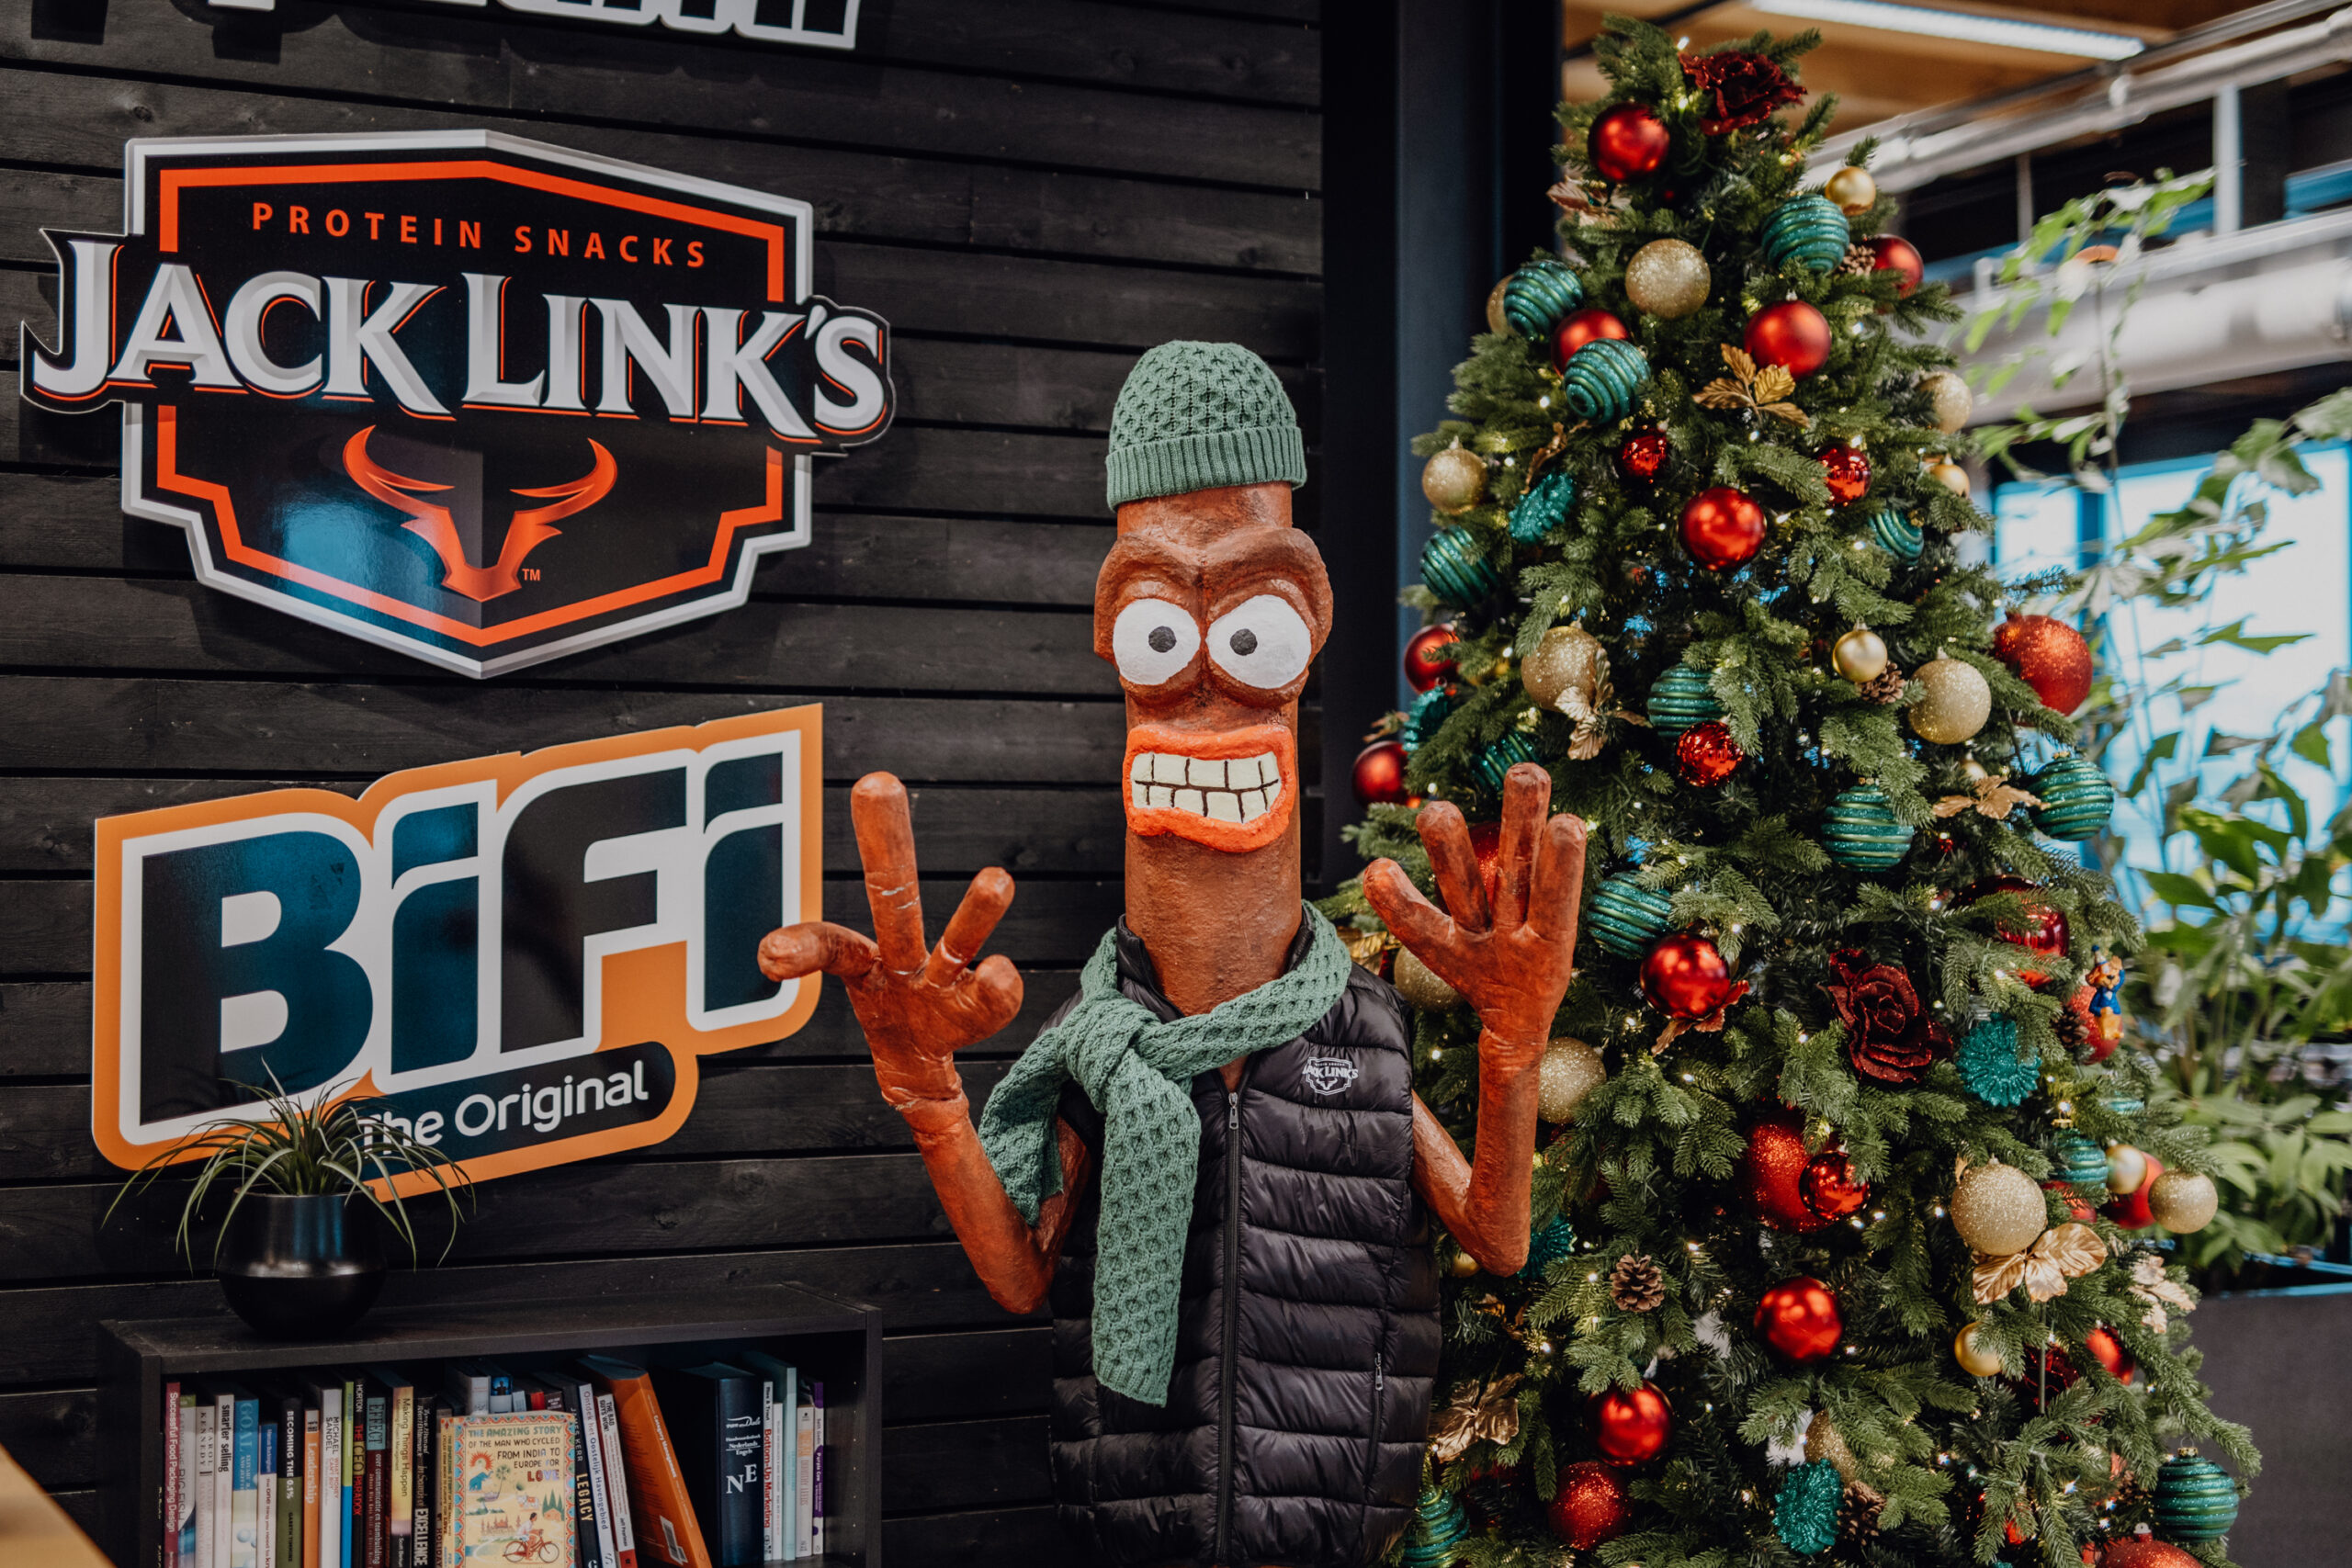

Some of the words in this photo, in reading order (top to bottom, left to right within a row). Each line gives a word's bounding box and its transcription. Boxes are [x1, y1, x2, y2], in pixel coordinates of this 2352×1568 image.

[252, 202, 481, 249] PROTEIN
[514, 225, 705, 268] SNACKS
[32, 237, 452, 420] JACK
[459, 272, 888, 443] LINK'S
[522, 568, 541, 581] TM
[138, 750, 784, 1126] BiFi
[357, 1110, 445, 1159] The
[454, 1059, 650, 1137] Original
[355, 1383, 364, 1413] HORTON
[401, 1397, 411, 1429] Making
[583, 1391, 594, 1421] Ontdek
[599, 1399, 608, 1416] GUYS
[169, 1392, 178, 1438] Successful
[221, 1404, 231, 1440] smarter
[239, 1402, 253, 1452] GOAL
[368, 1404, 384, 1445] EFFECT
[607, 1414, 616, 1427] BAD
[354, 1424, 364, 1441] THE
[401, 1432, 411, 1461] Things
[468, 1429, 484, 1438] THE
[486, 1427, 530, 1437] AMAZING
[533, 1425, 563, 1435] STORY
[469, 1440, 477, 1449] OF
[494, 1438, 512, 1447] MAN
[513, 1438, 531, 1447] WHO
[532, 1437, 560, 1446] CYCLED
[653, 1415, 665, 1440] Category
[662, 1439, 677, 1478] Management
[169, 1439, 177, 1460] Food
[219, 1443, 231, 1472] selling
[353, 1444, 365, 1472] CEO
[497, 1450, 520, 1461] FROM
[523, 1448, 547, 1459] INDIA
[550, 1447, 560, 1457] TO
[514, 1460, 542, 1469] EUROPE
[545, 1459, 560, 1467] FOR
[574, 1438, 584, 1462] KERR
[590, 1437, 600, 1475] Oostelijk
[763, 1428, 773, 1481] Bottom-Up
[167, 1461, 177, 1504] Packaging
[178, 1468, 187, 1488] BIG
[286, 1479, 294, 1500] 0.1%
[305, 1442, 318, 1505] Leadership
[401, 1462, 410, 1497] Happen
[526, 1469, 560, 1483] LOVE
[353, 1474, 362, 1517] PARADOX
[374, 1468, 383, 1512] communicatie
[576, 1472, 594, 1521] LEGACY
[594, 1476, 609, 1530] Havengebied
[763, 1481, 772, 1529] Marketing
[166, 1505, 176, 1532] Design
[178, 1493, 187, 1521] FISH
[375, 1513, 380, 1521] en
[372, 1521, 383, 1565] teambuilding
[414, 1507, 429, 1567] EXCELLENCE
